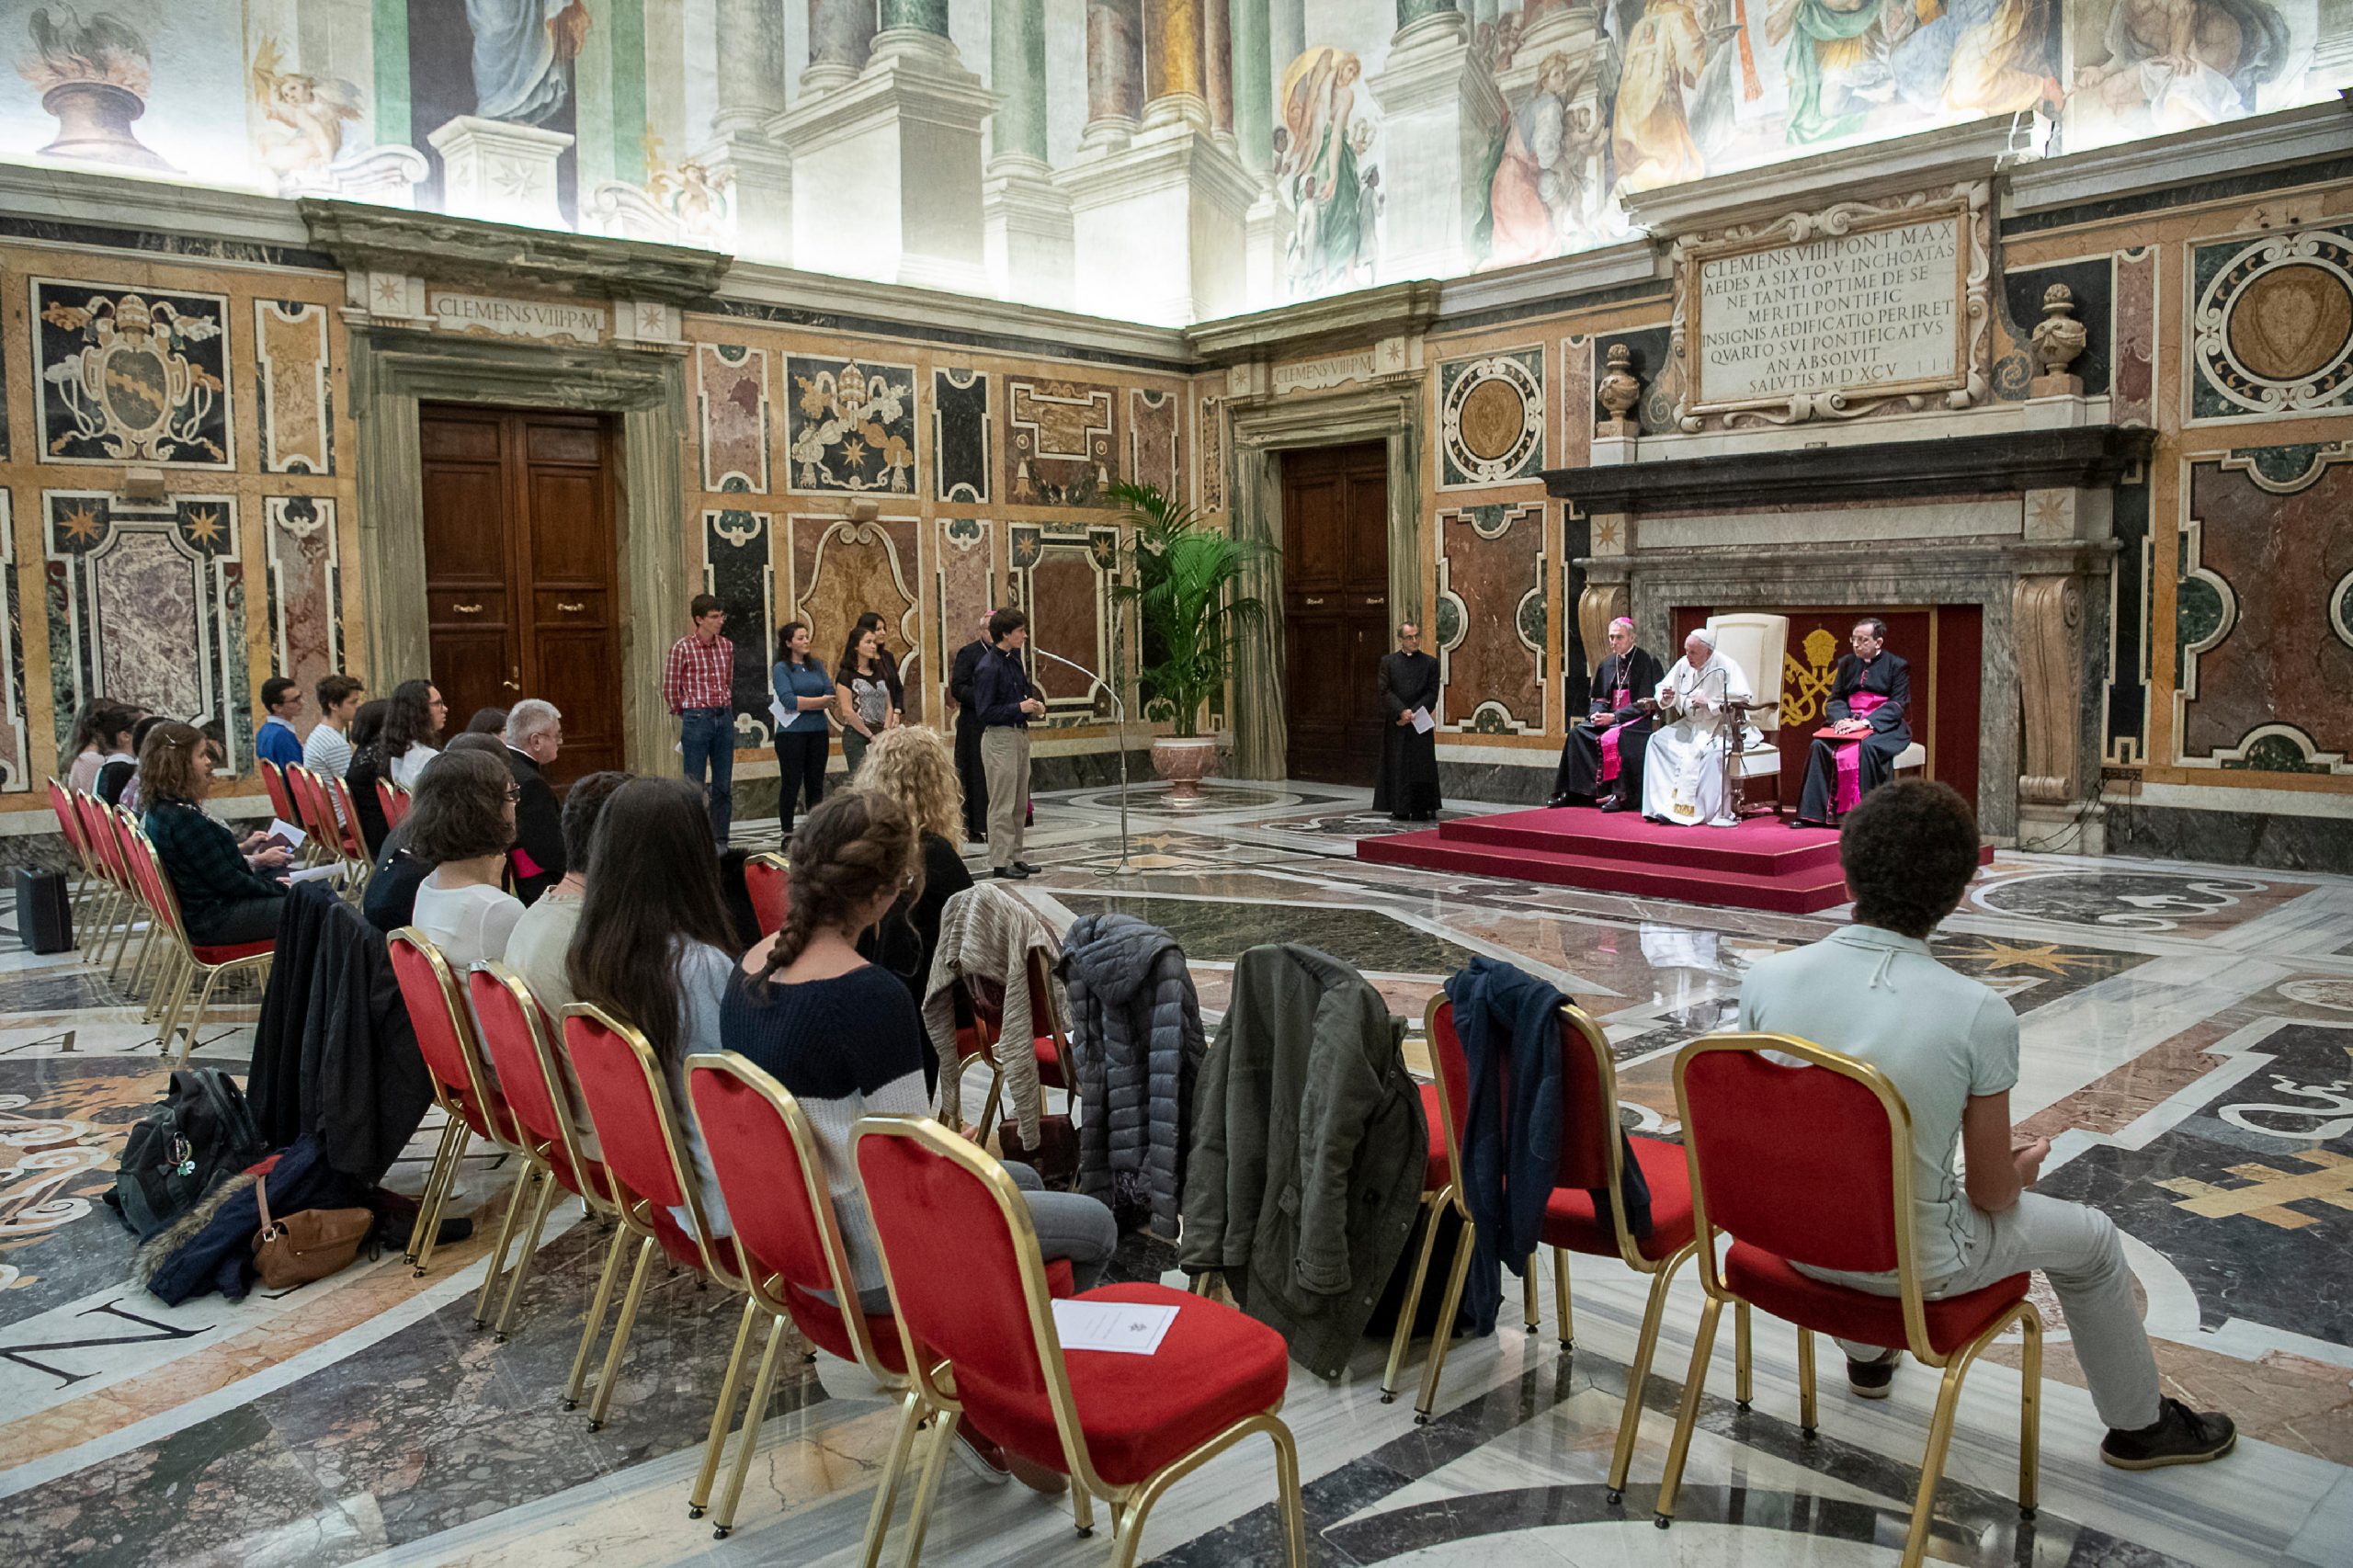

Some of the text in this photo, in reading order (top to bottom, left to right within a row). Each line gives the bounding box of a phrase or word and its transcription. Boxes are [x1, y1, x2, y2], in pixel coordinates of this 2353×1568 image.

[1704, 250, 1790, 278] CLEMENS
[1901, 222, 1952, 246] MAX
[1704, 277, 1750, 297] AEDES
[1756, 274, 1767, 288] A
[1726, 265, 1929, 310] NE TANTI OPTIME DE SE
[438, 298, 531, 323] CLEMENS
[1702, 299, 1954, 348] INSIGNIS AEDIFICATIO PERIRET
[1748, 289, 1903, 324] MERITI PONTIFIC
[1711, 320, 1944, 366] QVARTO SVI PONTIFICATVS
[1276, 364, 1327, 383] CLEMENS
[1749, 372, 1815, 393] SALVTIS
